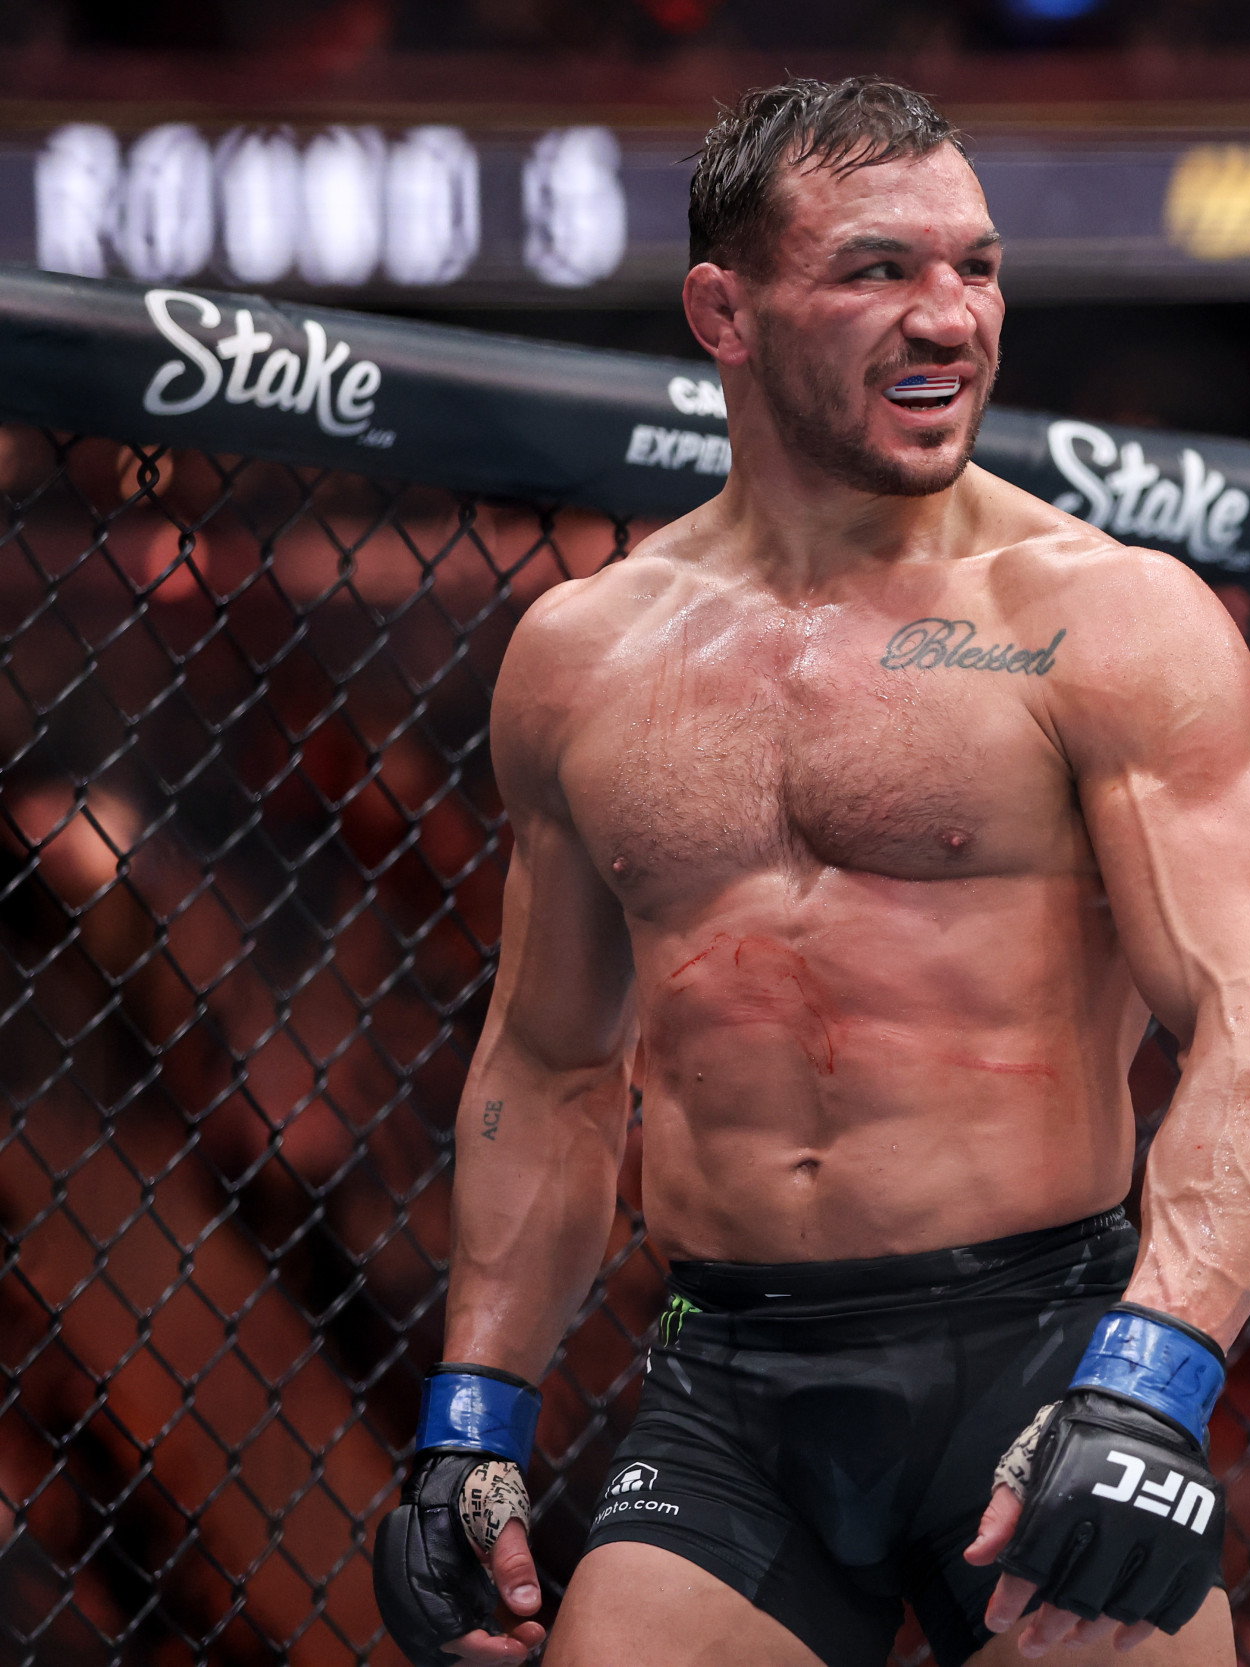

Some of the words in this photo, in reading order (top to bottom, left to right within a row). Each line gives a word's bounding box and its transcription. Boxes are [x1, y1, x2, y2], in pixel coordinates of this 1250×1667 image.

[144, 289, 382, 437] Stake
[1047, 419, 1250, 562] Stake
[880, 617, 1067, 676] Blessed
[481, 1101, 503, 1141] ACE
[1092, 1450, 1216, 1535] UFC
